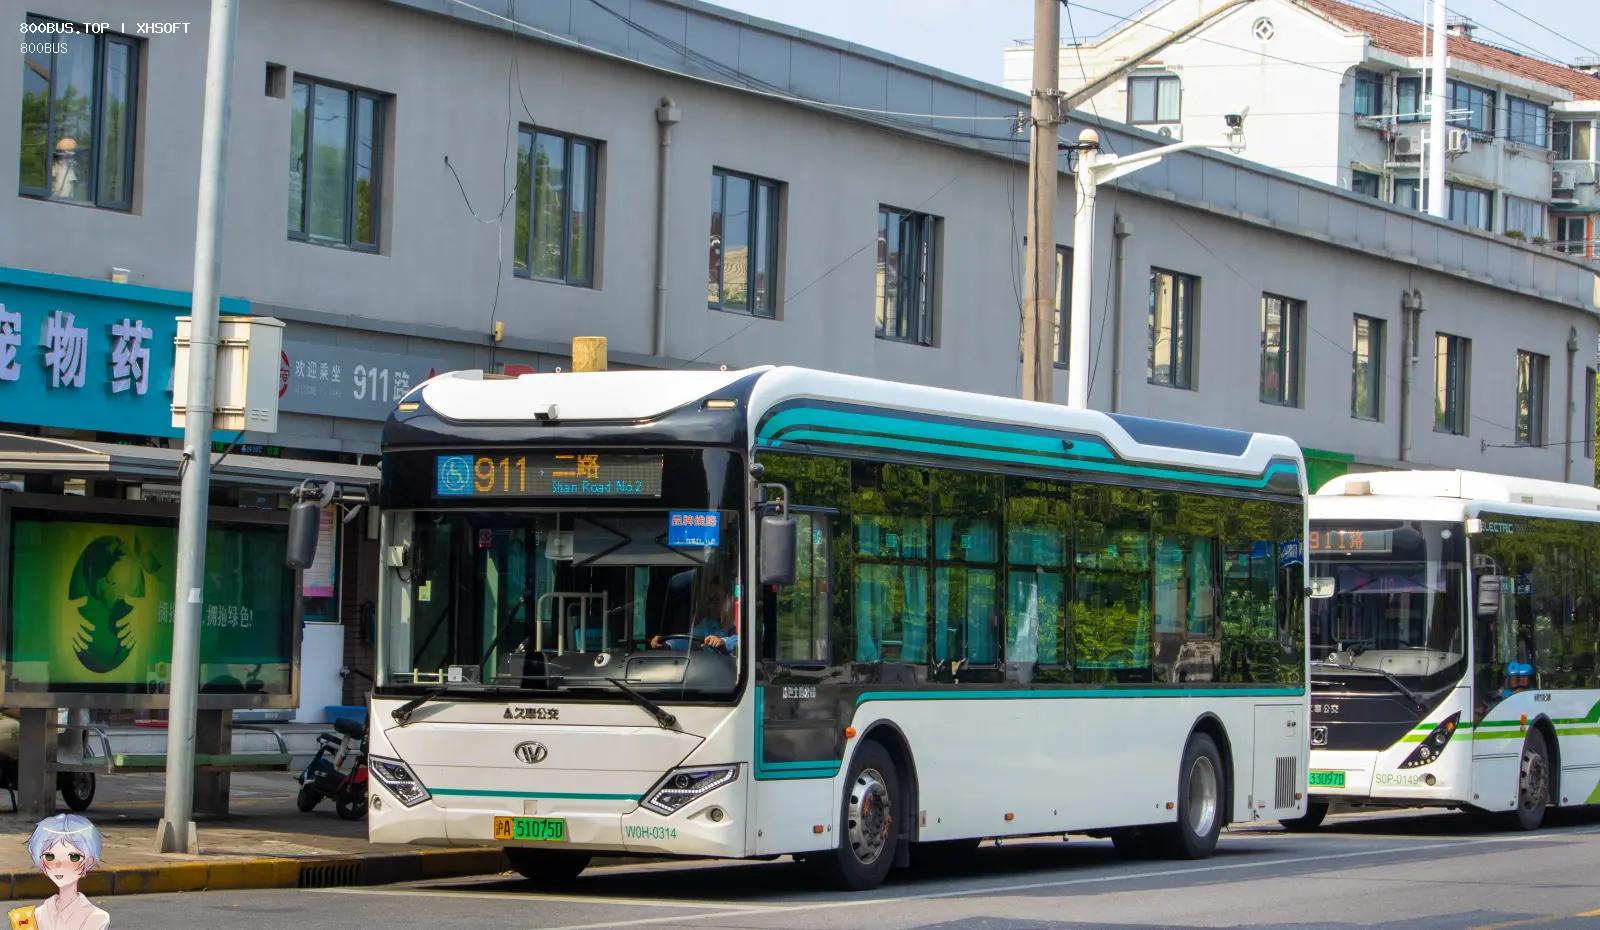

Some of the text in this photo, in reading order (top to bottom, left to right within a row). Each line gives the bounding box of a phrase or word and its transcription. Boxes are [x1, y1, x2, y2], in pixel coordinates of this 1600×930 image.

[0, 303, 173, 395] 宠物药
[294, 359, 341, 383] 欢迎乘坐
[353, 364, 411, 402] 911路
[474, 454, 600, 492] 911 二路
[581, 480, 611, 493] Road
[615, 480, 642, 493] No.2
[1309, 531, 1364, 550] 911路
[1309, 772, 1344, 785] 33097D
[517, 820, 563, 838] 51075D
